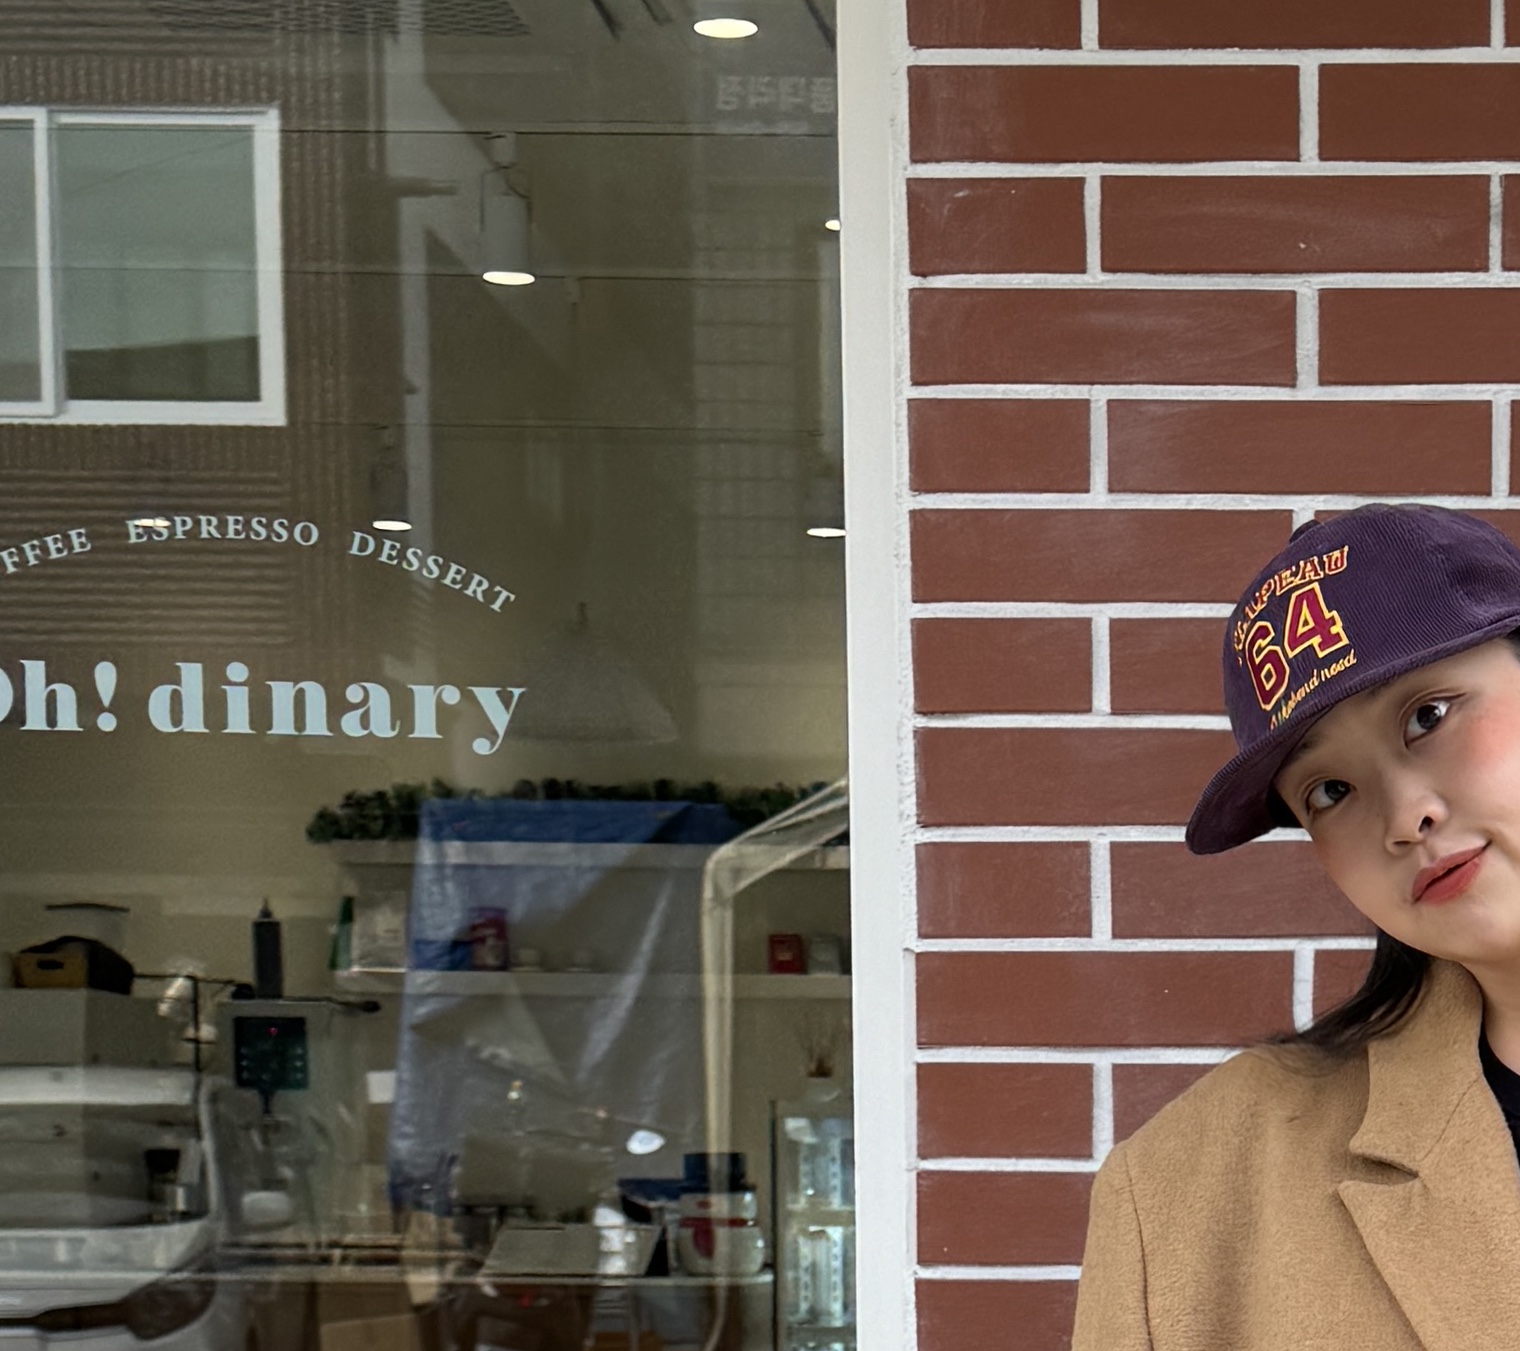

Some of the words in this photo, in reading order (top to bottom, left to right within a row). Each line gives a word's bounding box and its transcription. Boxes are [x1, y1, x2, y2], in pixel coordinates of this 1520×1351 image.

[127, 516, 320, 547] ESPRESSO
[349, 530, 516, 613] DESSERT
[1245, 582, 1350, 711] 64
[0, 660, 118, 733] h!
[148, 662, 528, 756] dinary
